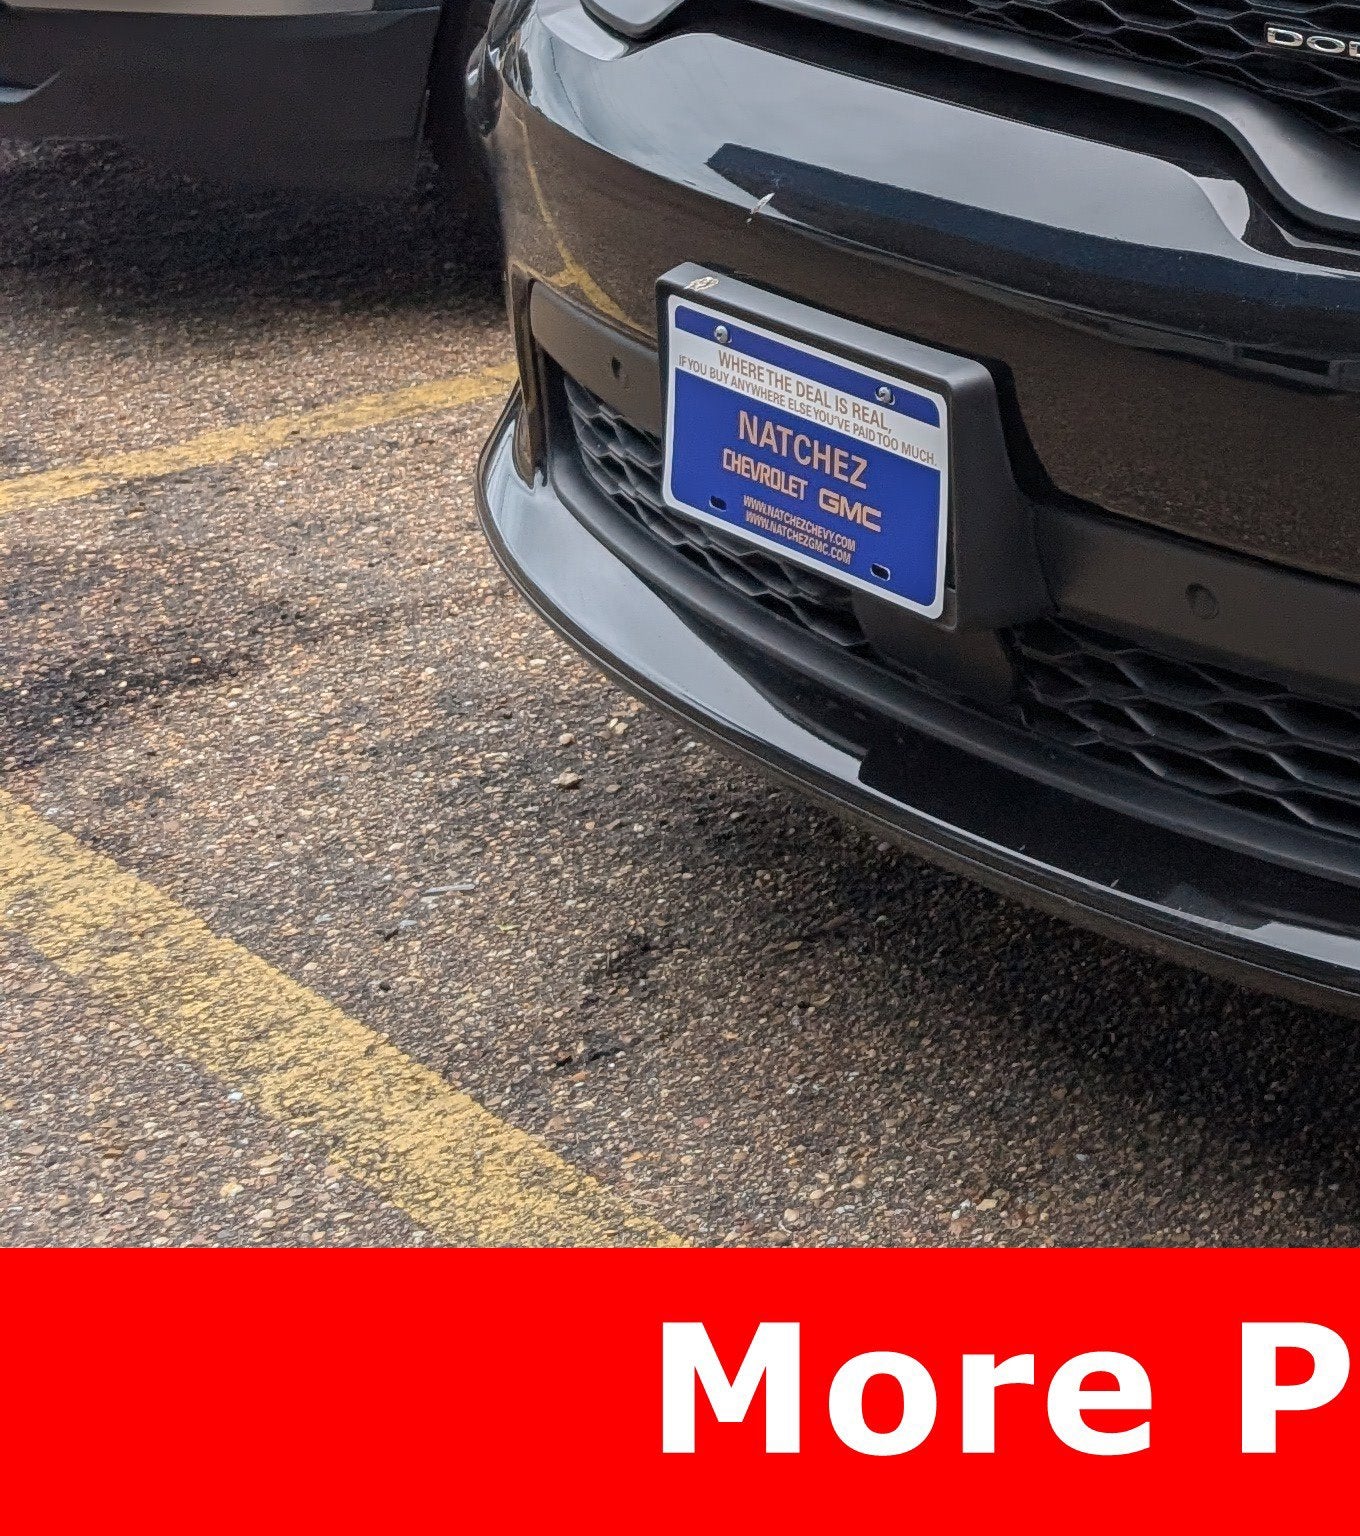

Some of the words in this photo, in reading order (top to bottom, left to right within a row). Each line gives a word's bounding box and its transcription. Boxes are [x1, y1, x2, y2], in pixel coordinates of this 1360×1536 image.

[679, 354, 687, 367] IF
[688, 358, 707, 375] YOU
[710, 367, 729, 384] BUY
[731, 373, 786, 407] ANYWHERE
[788, 397, 811, 418] ELSE
[813, 407, 850, 433] YOU'VE
[853, 422, 876, 442] PAID
[877, 432, 898, 451] TOO
[902, 441, 937, 466] MUCH.
[719, 349, 764, 383] WHERE
[766, 368, 792, 394] THE
[796, 380, 831, 409] DEAL
[835, 395, 848, 415] IS
[852, 401, 892, 434] REAL,
[723, 448, 808, 501] CHEVROLET
[819, 487, 882, 533] GMC
[739, 410, 868, 489] NATCHEZ
[743, 494, 856, 552] WWW.NATCHEZCHEVY.COM
[745, 510, 851, 565] WWW.NATCHEZGMC.COM
